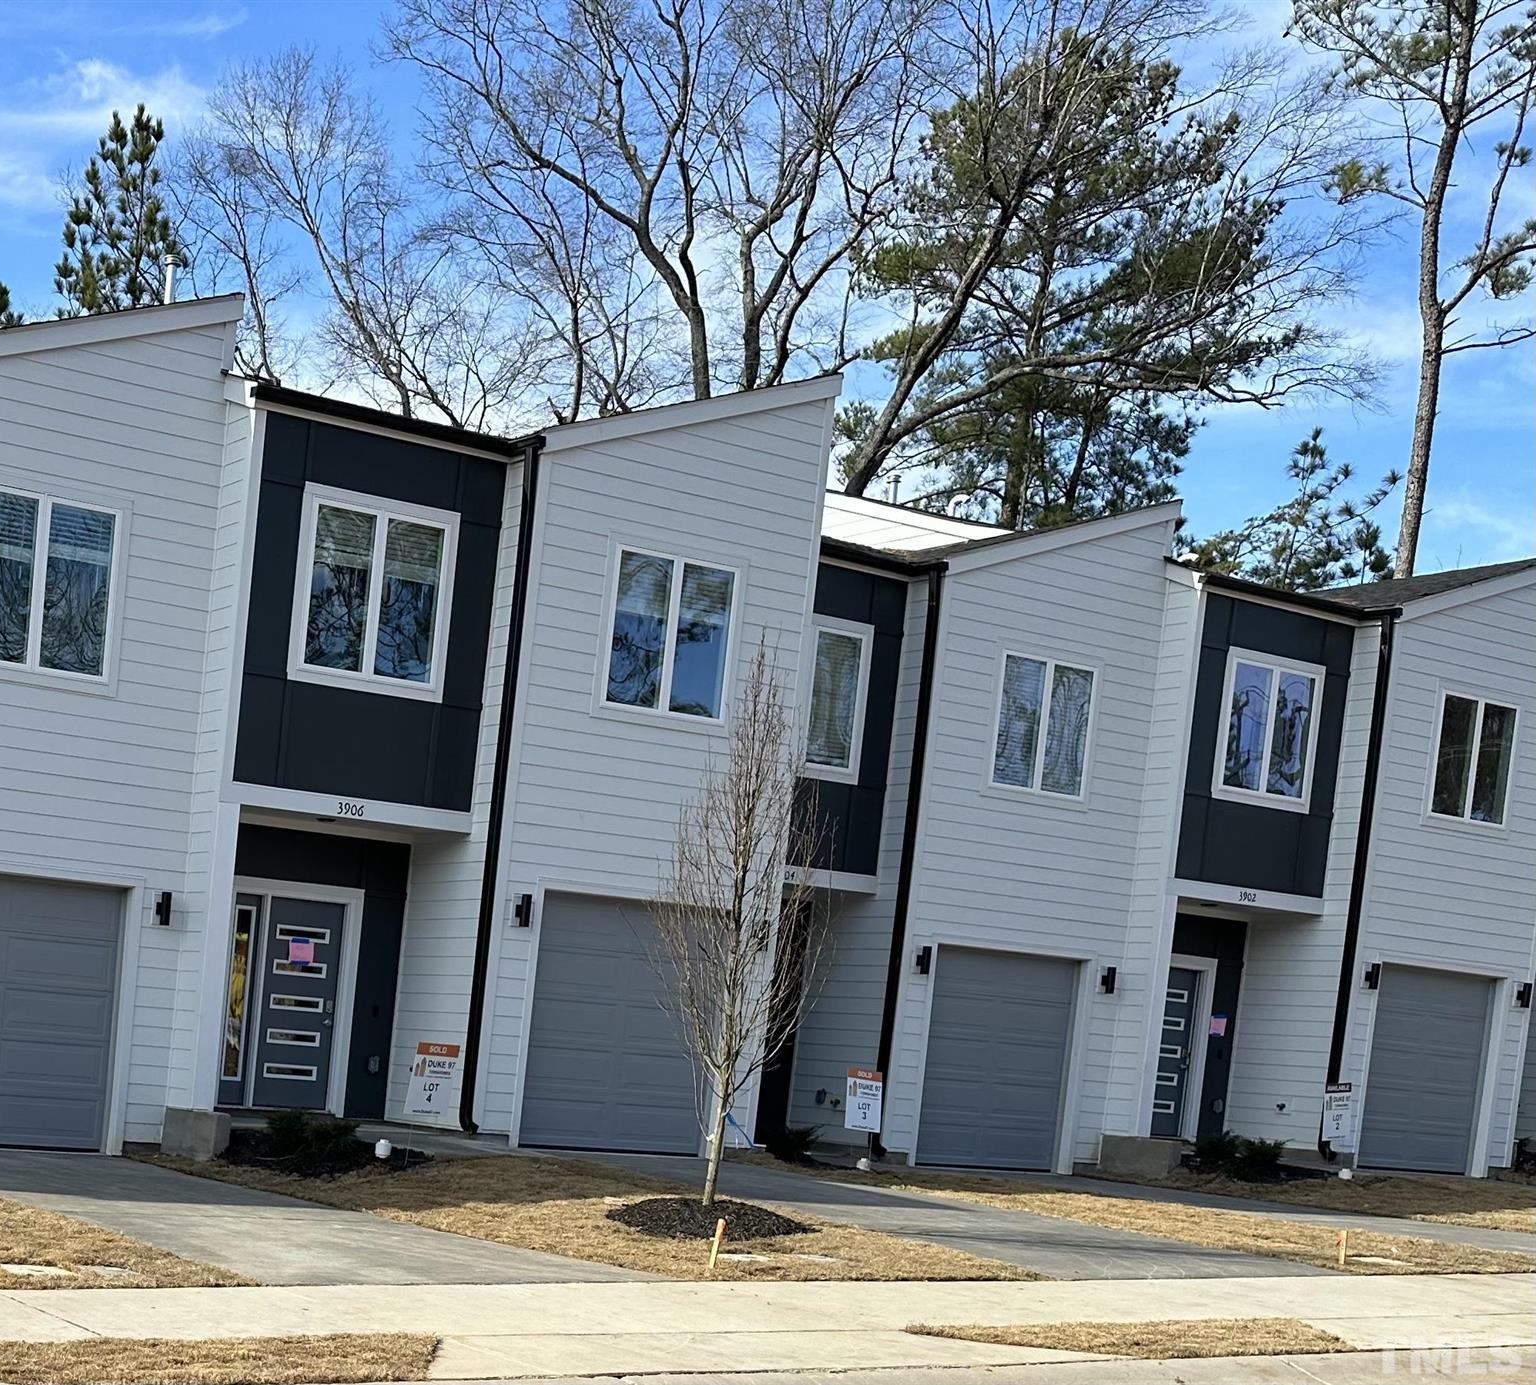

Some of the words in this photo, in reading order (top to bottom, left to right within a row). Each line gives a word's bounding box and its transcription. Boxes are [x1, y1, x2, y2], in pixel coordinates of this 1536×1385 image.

[337, 801, 365, 817] 3906
[1238, 891, 1257, 903] 3902
[428, 1045, 448, 1054] SOLD
[427, 1060, 447, 1069] DUKE
[447, 1061, 456, 1070] 97
[856, 1070, 873, 1079] SOLD
[423, 1082, 440, 1092] LOT
[858, 1082, 874, 1092] DUKE
[425, 1093, 432, 1103] 4
[857, 1102, 871, 1111] LOT
[862, 1111, 867, 1120] 3
[1332, 1114, 1343, 1122] LOT
[1335, 1122, 1340, 1131] 2
